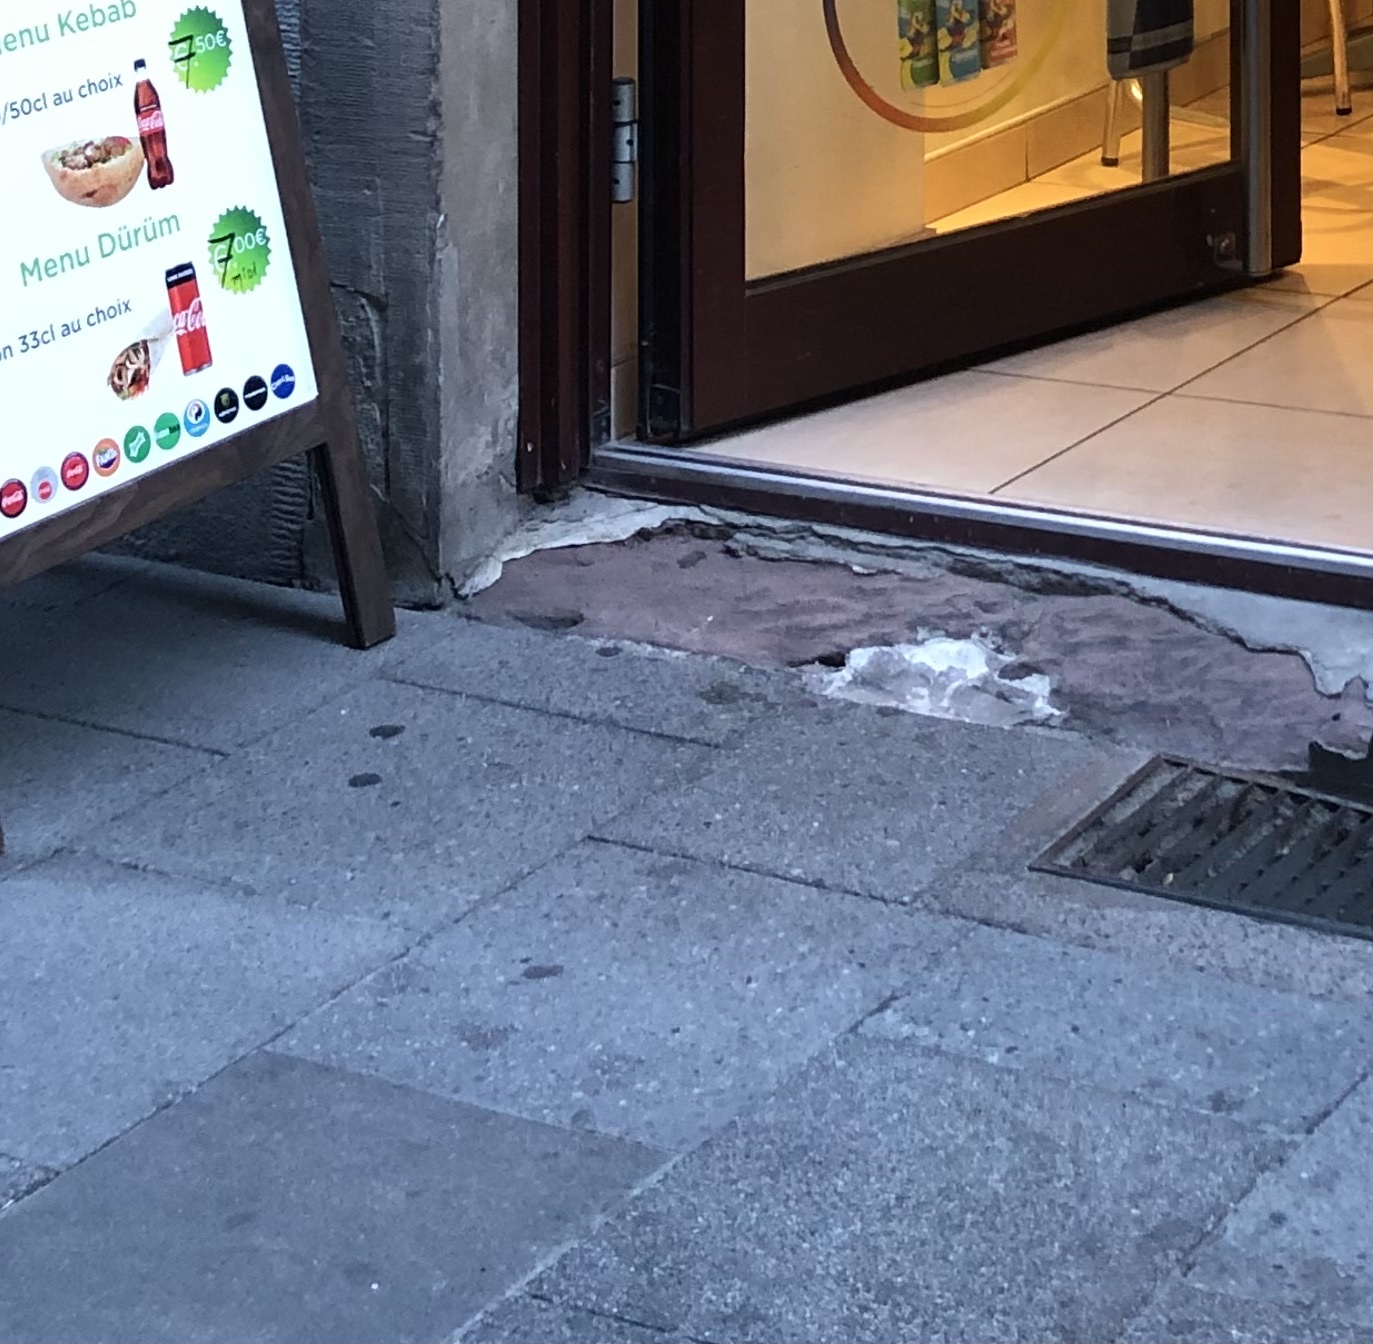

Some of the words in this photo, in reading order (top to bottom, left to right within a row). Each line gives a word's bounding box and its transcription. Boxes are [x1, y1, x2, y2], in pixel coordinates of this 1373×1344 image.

[0, 23, 50, 54] enu
[0, 92, 48, 125] /50cl
[53, 91, 73, 107] au
[78, 73, 123, 99] choix
[20, 245, 90, 287] Menu
[97, 214, 181, 259] Dürüm
[18, 324, 55, 354] 33cl
[61, 318, 82, 337] au
[87, 298, 132, 327] choix
